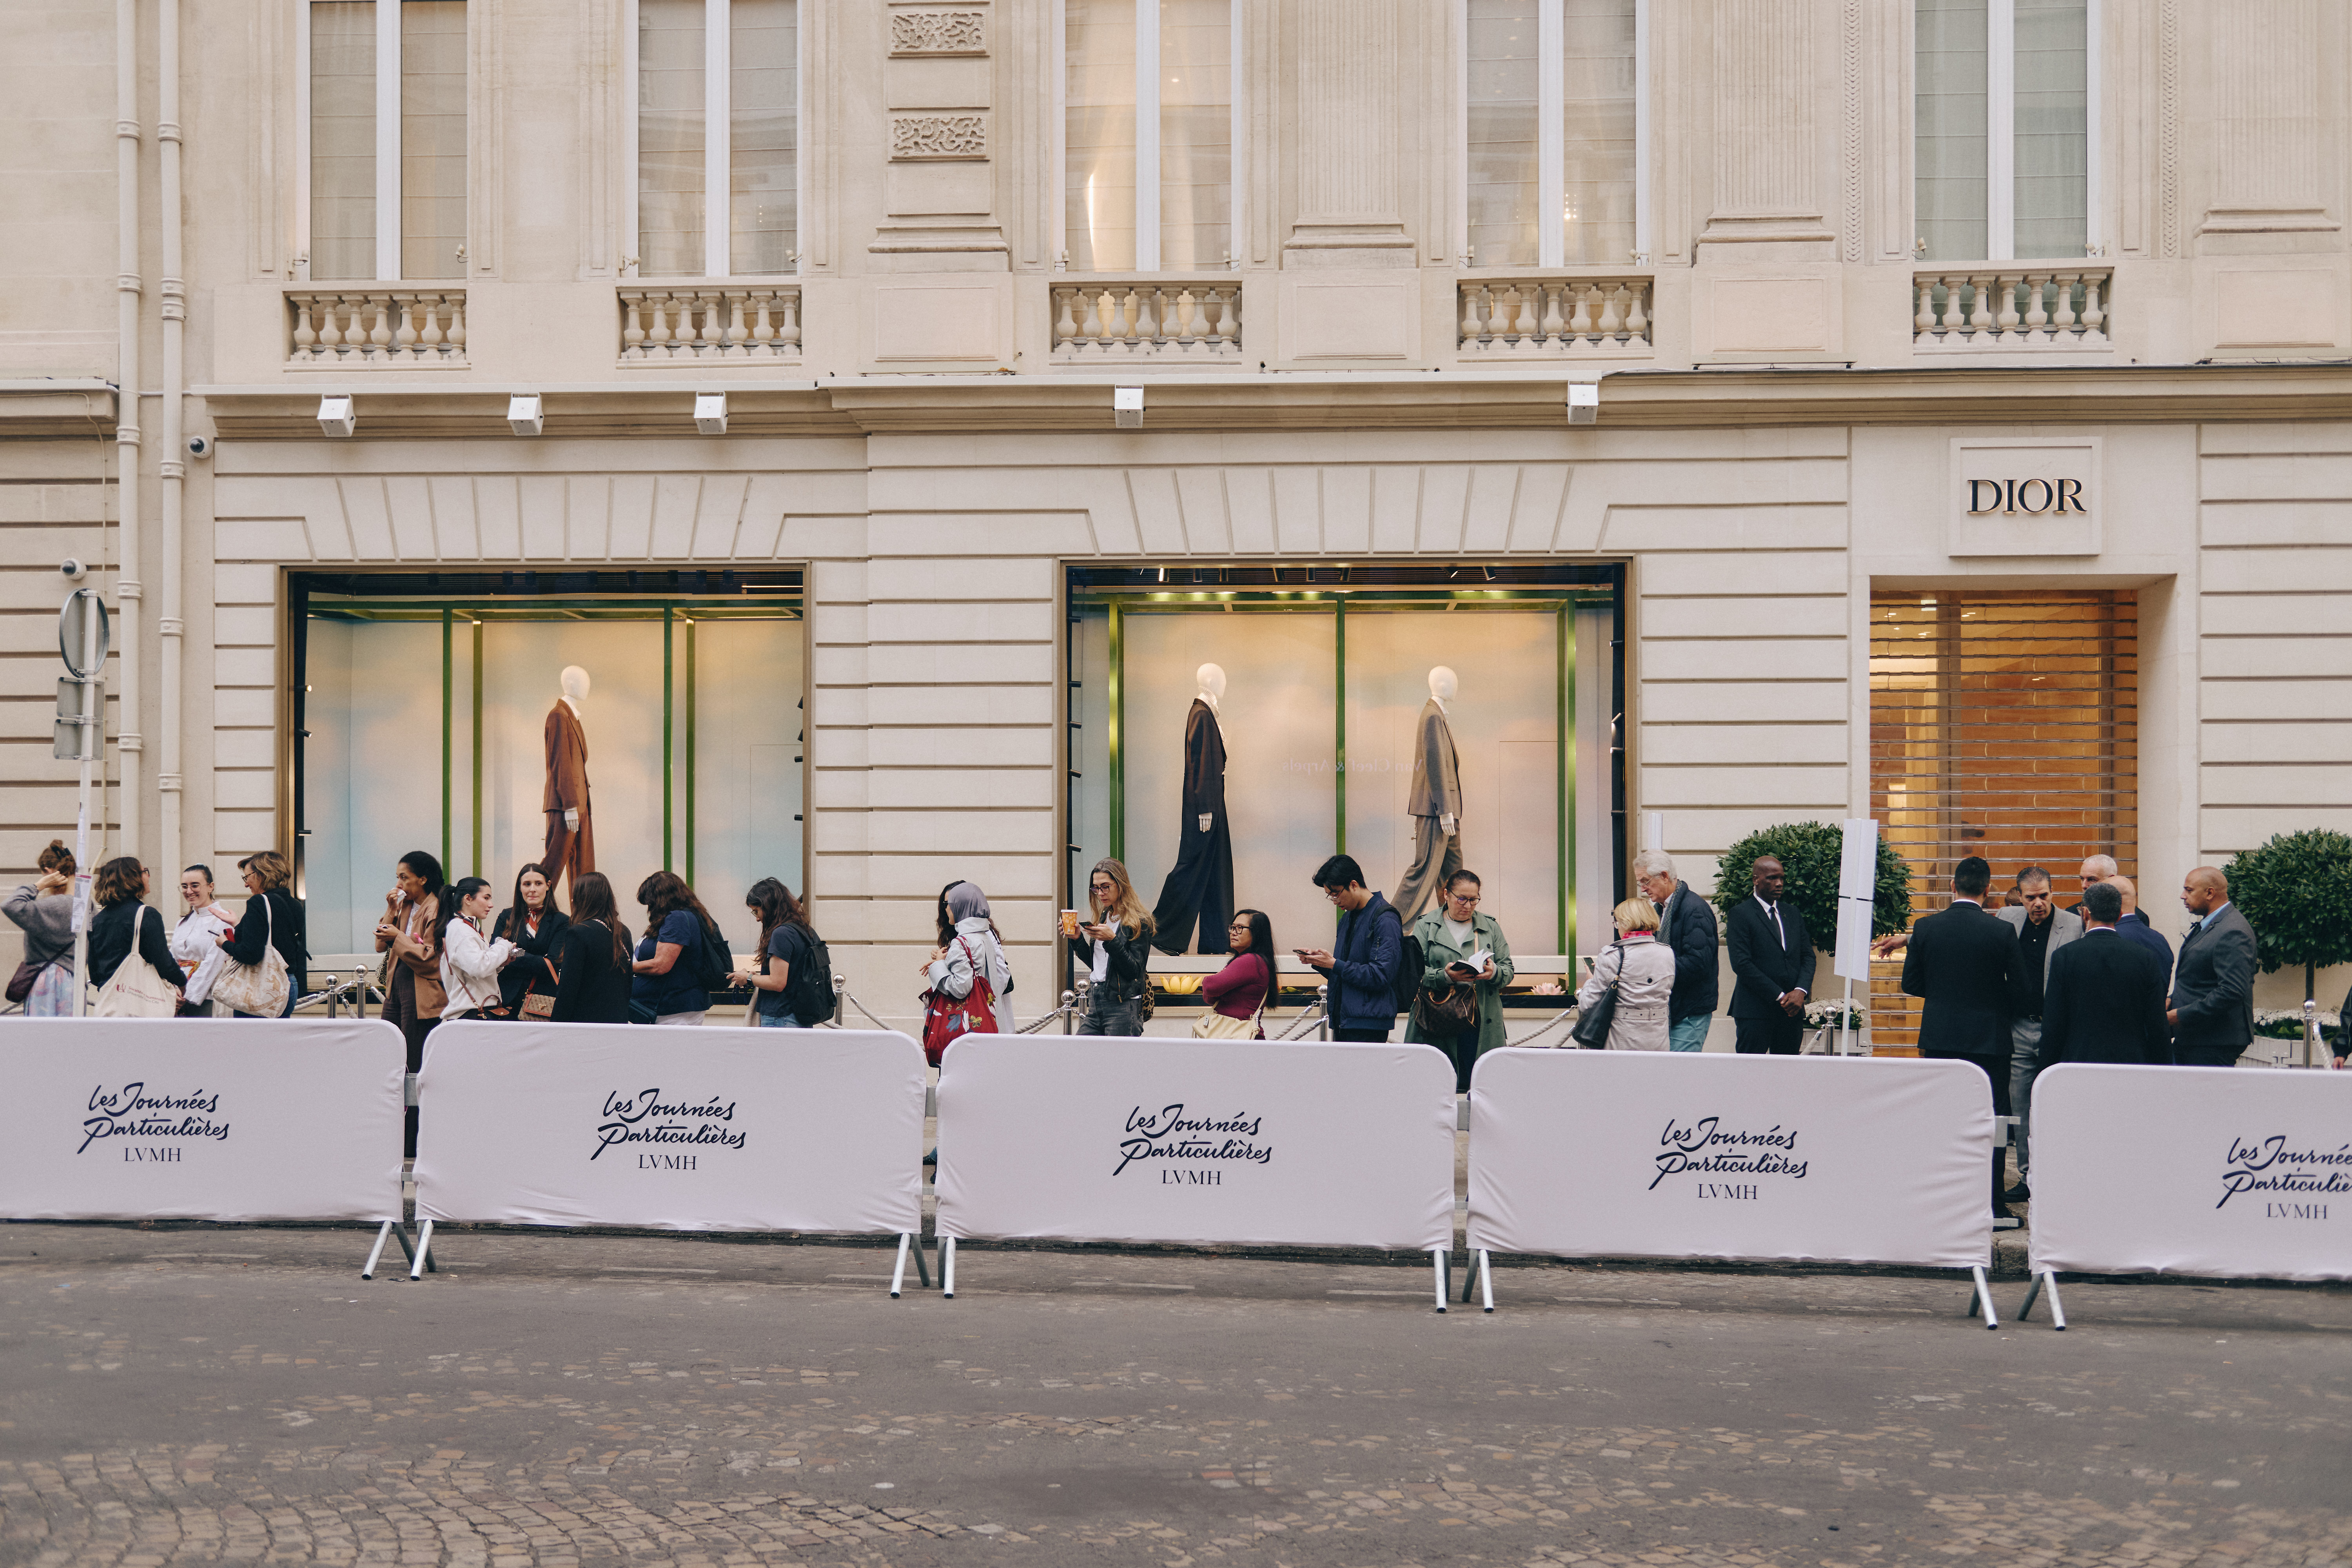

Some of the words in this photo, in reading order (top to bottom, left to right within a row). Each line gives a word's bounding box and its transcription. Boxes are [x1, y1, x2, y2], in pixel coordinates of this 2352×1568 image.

[1967, 479, 2087, 513] DIOR
[103, 1082, 219, 1117] Journées
[618, 1088, 736, 1123] Journées
[76, 1112, 229, 1154] Particulières
[1141, 1103, 1262, 1139] Journées
[1677, 1116, 1797, 1152] Journées
[124, 1147, 181, 1161] LVMH
[590, 1119, 746, 1161] Particulières
[1112, 1134, 1272, 1176] Particulières
[638, 1154, 697, 1170] LVMH
[1161, 1170, 1222, 1185] LVMH
[1648, 1148, 1808, 1191] Particulières
[1697, 1183, 1758, 1200] LVMH
[2267, 1203, 2328, 1219] LVMH
